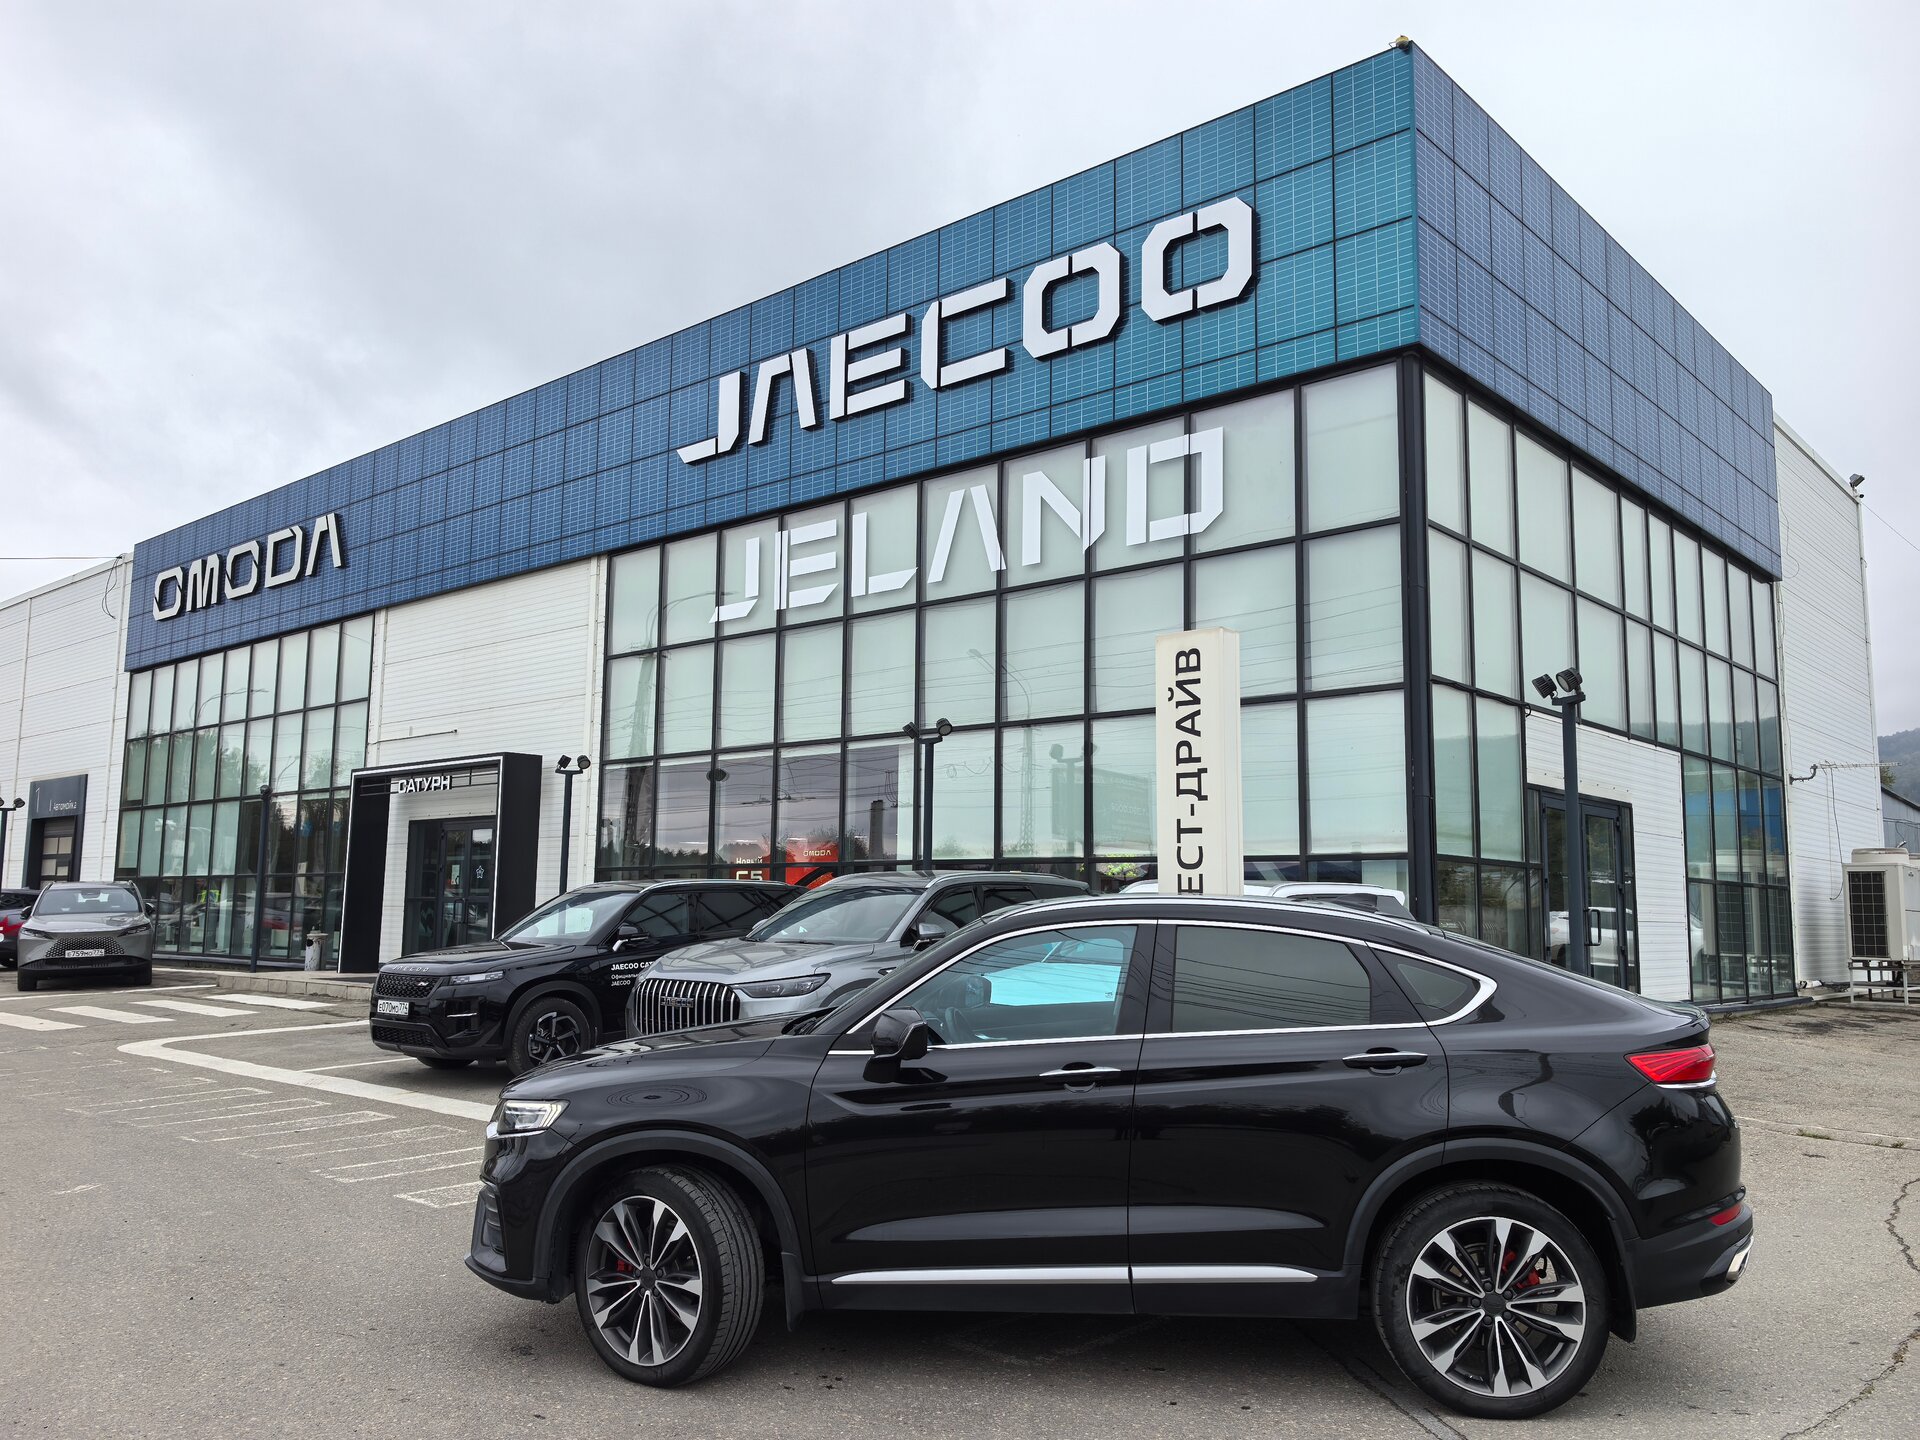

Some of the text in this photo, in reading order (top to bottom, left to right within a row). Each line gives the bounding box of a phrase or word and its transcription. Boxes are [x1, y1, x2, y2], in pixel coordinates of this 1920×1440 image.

[676, 196, 1255, 465] JAECOO
[709, 426, 1225, 623] JELAND
[152, 512, 343, 621] OMODA
[397, 775, 451, 794] САТУРН
[802, 849, 832, 857] OMODA
[611, 962, 639, 971] JAECOO
